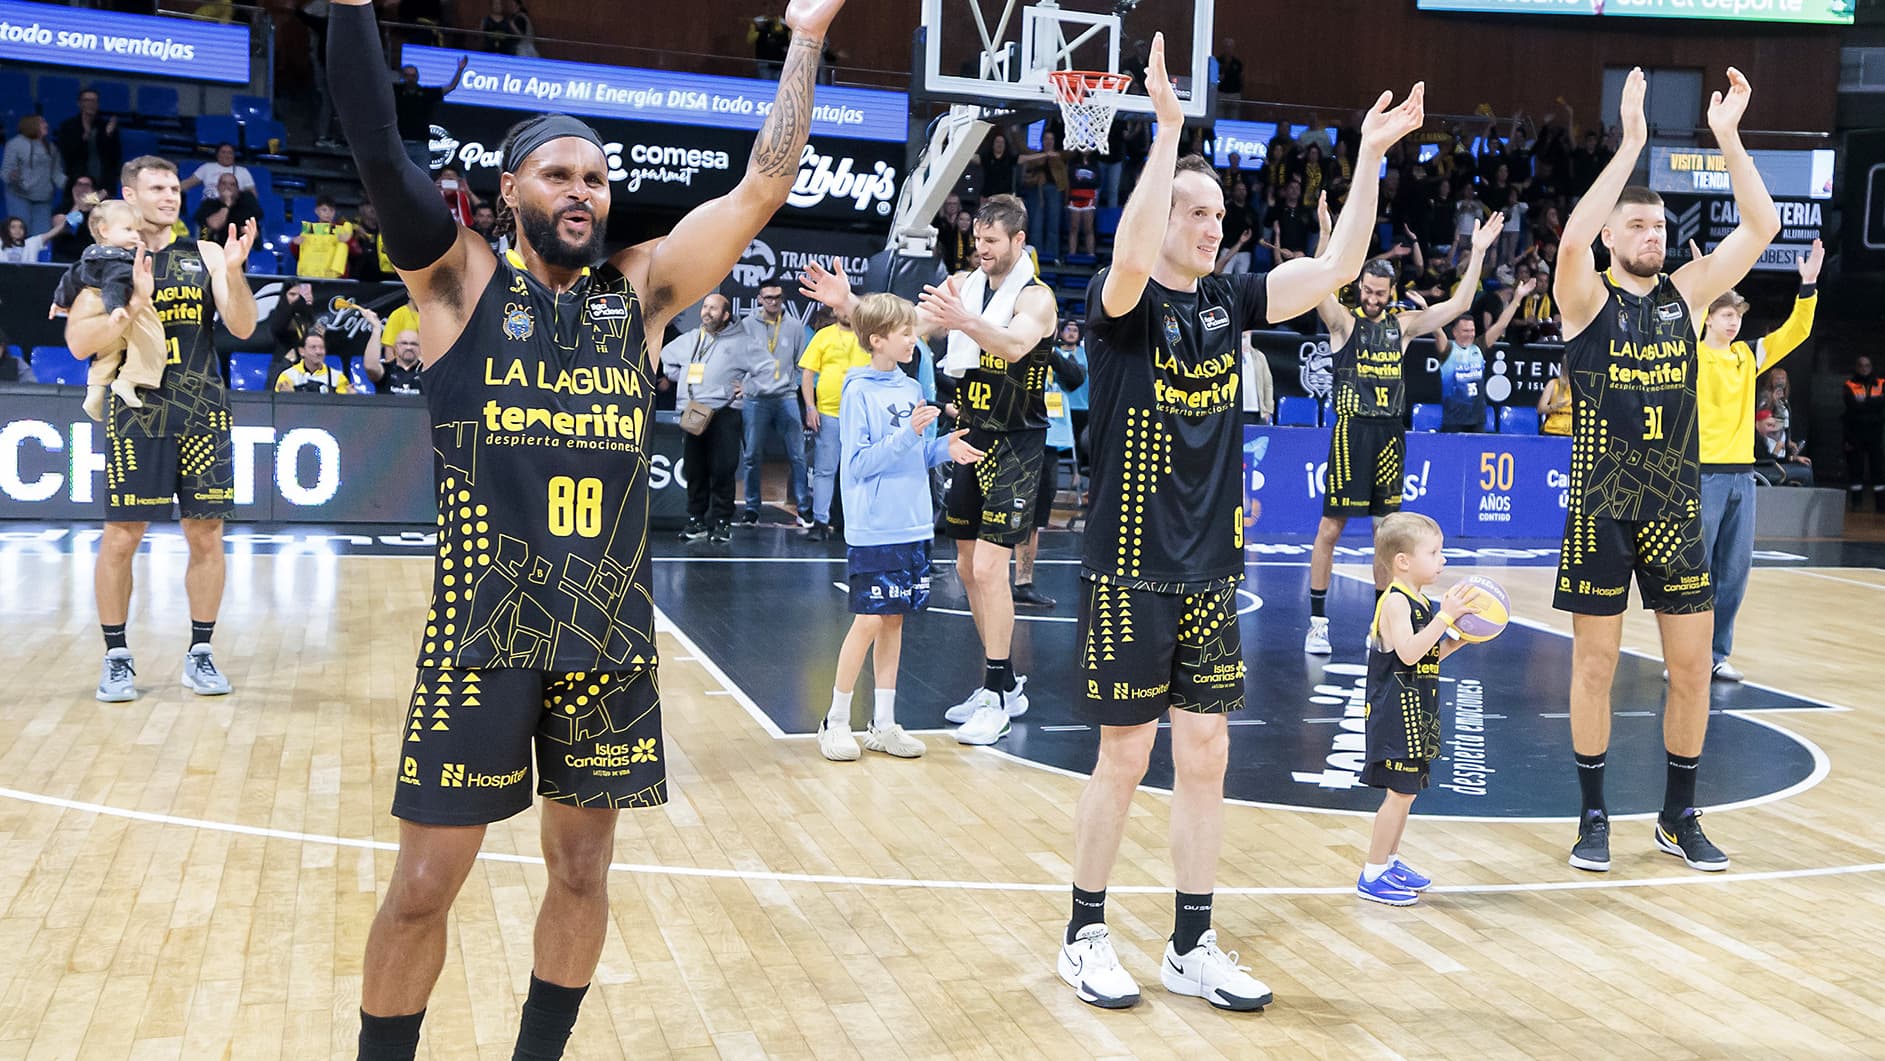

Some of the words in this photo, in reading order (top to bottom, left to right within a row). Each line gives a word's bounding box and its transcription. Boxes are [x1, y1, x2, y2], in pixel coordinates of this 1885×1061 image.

[0, 22, 52, 45] todo
[56, 30, 97, 50] son
[103, 35, 195, 61] ventajas
[462, 70, 498, 91] Con
[503, 73, 522, 94] la
[525, 77, 562, 100] App
[567, 81, 591, 98] Mi
[595, 83, 662, 108] Energía
[667, 90, 708, 110] DISA
[712, 96, 752, 114] todo
[811, 104, 864, 125] ntajas
[631, 144, 729, 169] comesa
[1671, 153, 1704, 171] VISITA
[628, 166, 698, 192] gourmet
[1692, 171, 1730, 190] TIENDA
[1609, 339, 1633, 358] LA
[1633, 339, 1687, 361] LAGUNA
[1155, 347, 1178, 375] LA
[1181, 349, 1236, 378] LAGUN
[1608, 360, 1687, 387] tenerife!
[485, 357, 528, 387] LA
[537, 361, 643, 399] LAGUNA
[968, 381, 992, 411] 42
[1375, 386, 1389, 407] 15
[483, 400, 644, 451] tenerife!
[1643, 406, 1664, 440] 31
[485, 433, 560, 447] despierta
[1479, 452, 1515, 491] 50
[548, 476, 603, 537] 88
[1479, 492, 1511, 512] AÑOS
[1234, 505, 1244, 549] 9
[1479, 511, 1511, 522] CONTIGO
[1664, 582, 1700, 592] Canarias
[1680, 575, 1699, 584] Islas
[1192, 672, 1236, 684] Canarias
[1213, 663, 1235, 674] Islas
[564, 754, 630, 768] Canarias
[595, 743, 629, 756] Islas
